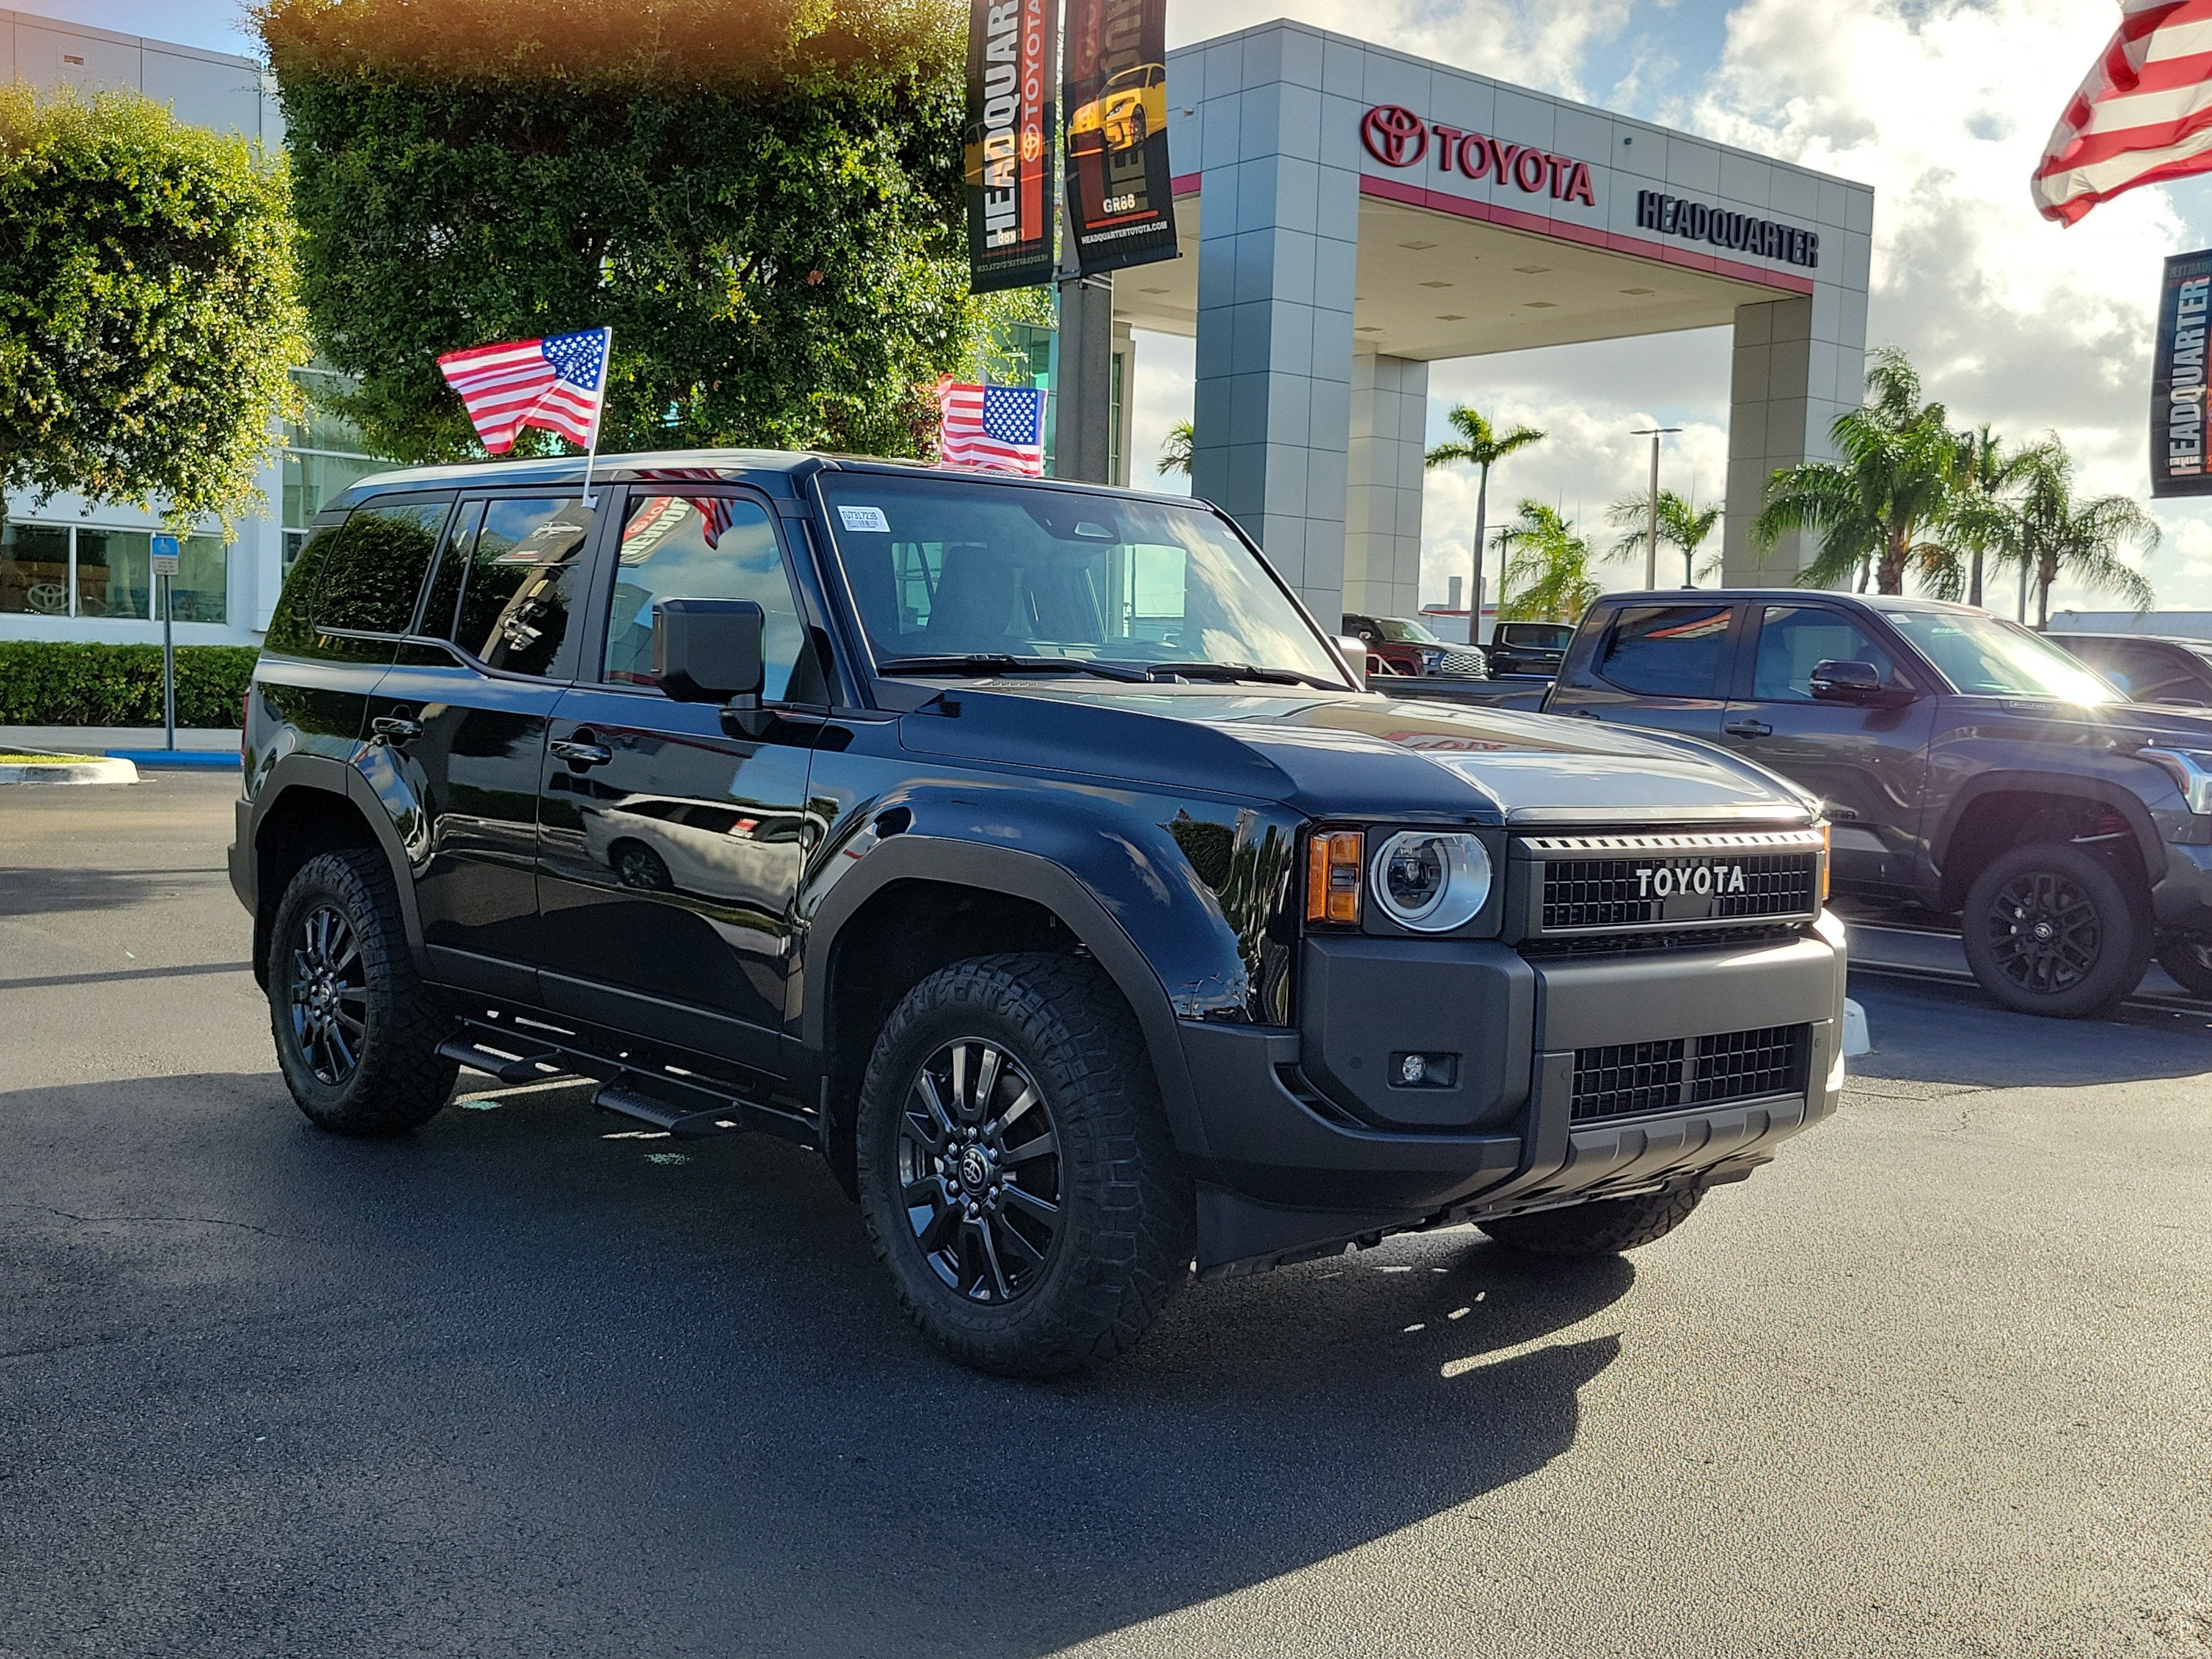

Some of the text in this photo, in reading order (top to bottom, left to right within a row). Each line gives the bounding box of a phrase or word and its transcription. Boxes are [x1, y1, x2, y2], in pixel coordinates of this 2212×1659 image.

[984, 0, 1021, 249] HEADQUAR
[1103, 193, 1136, 213] GR86
[1432, 125, 1596, 207] TOYOTA
[1081, 221, 1168, 245] HEADQUARTERTOYOTA.COM
[1637, 189, 1819, 268] HEADQUARTER
[2169, 274, 2210, 476] HEADQUARTER
[1635, 865, 1745, 897] TOYOTA
